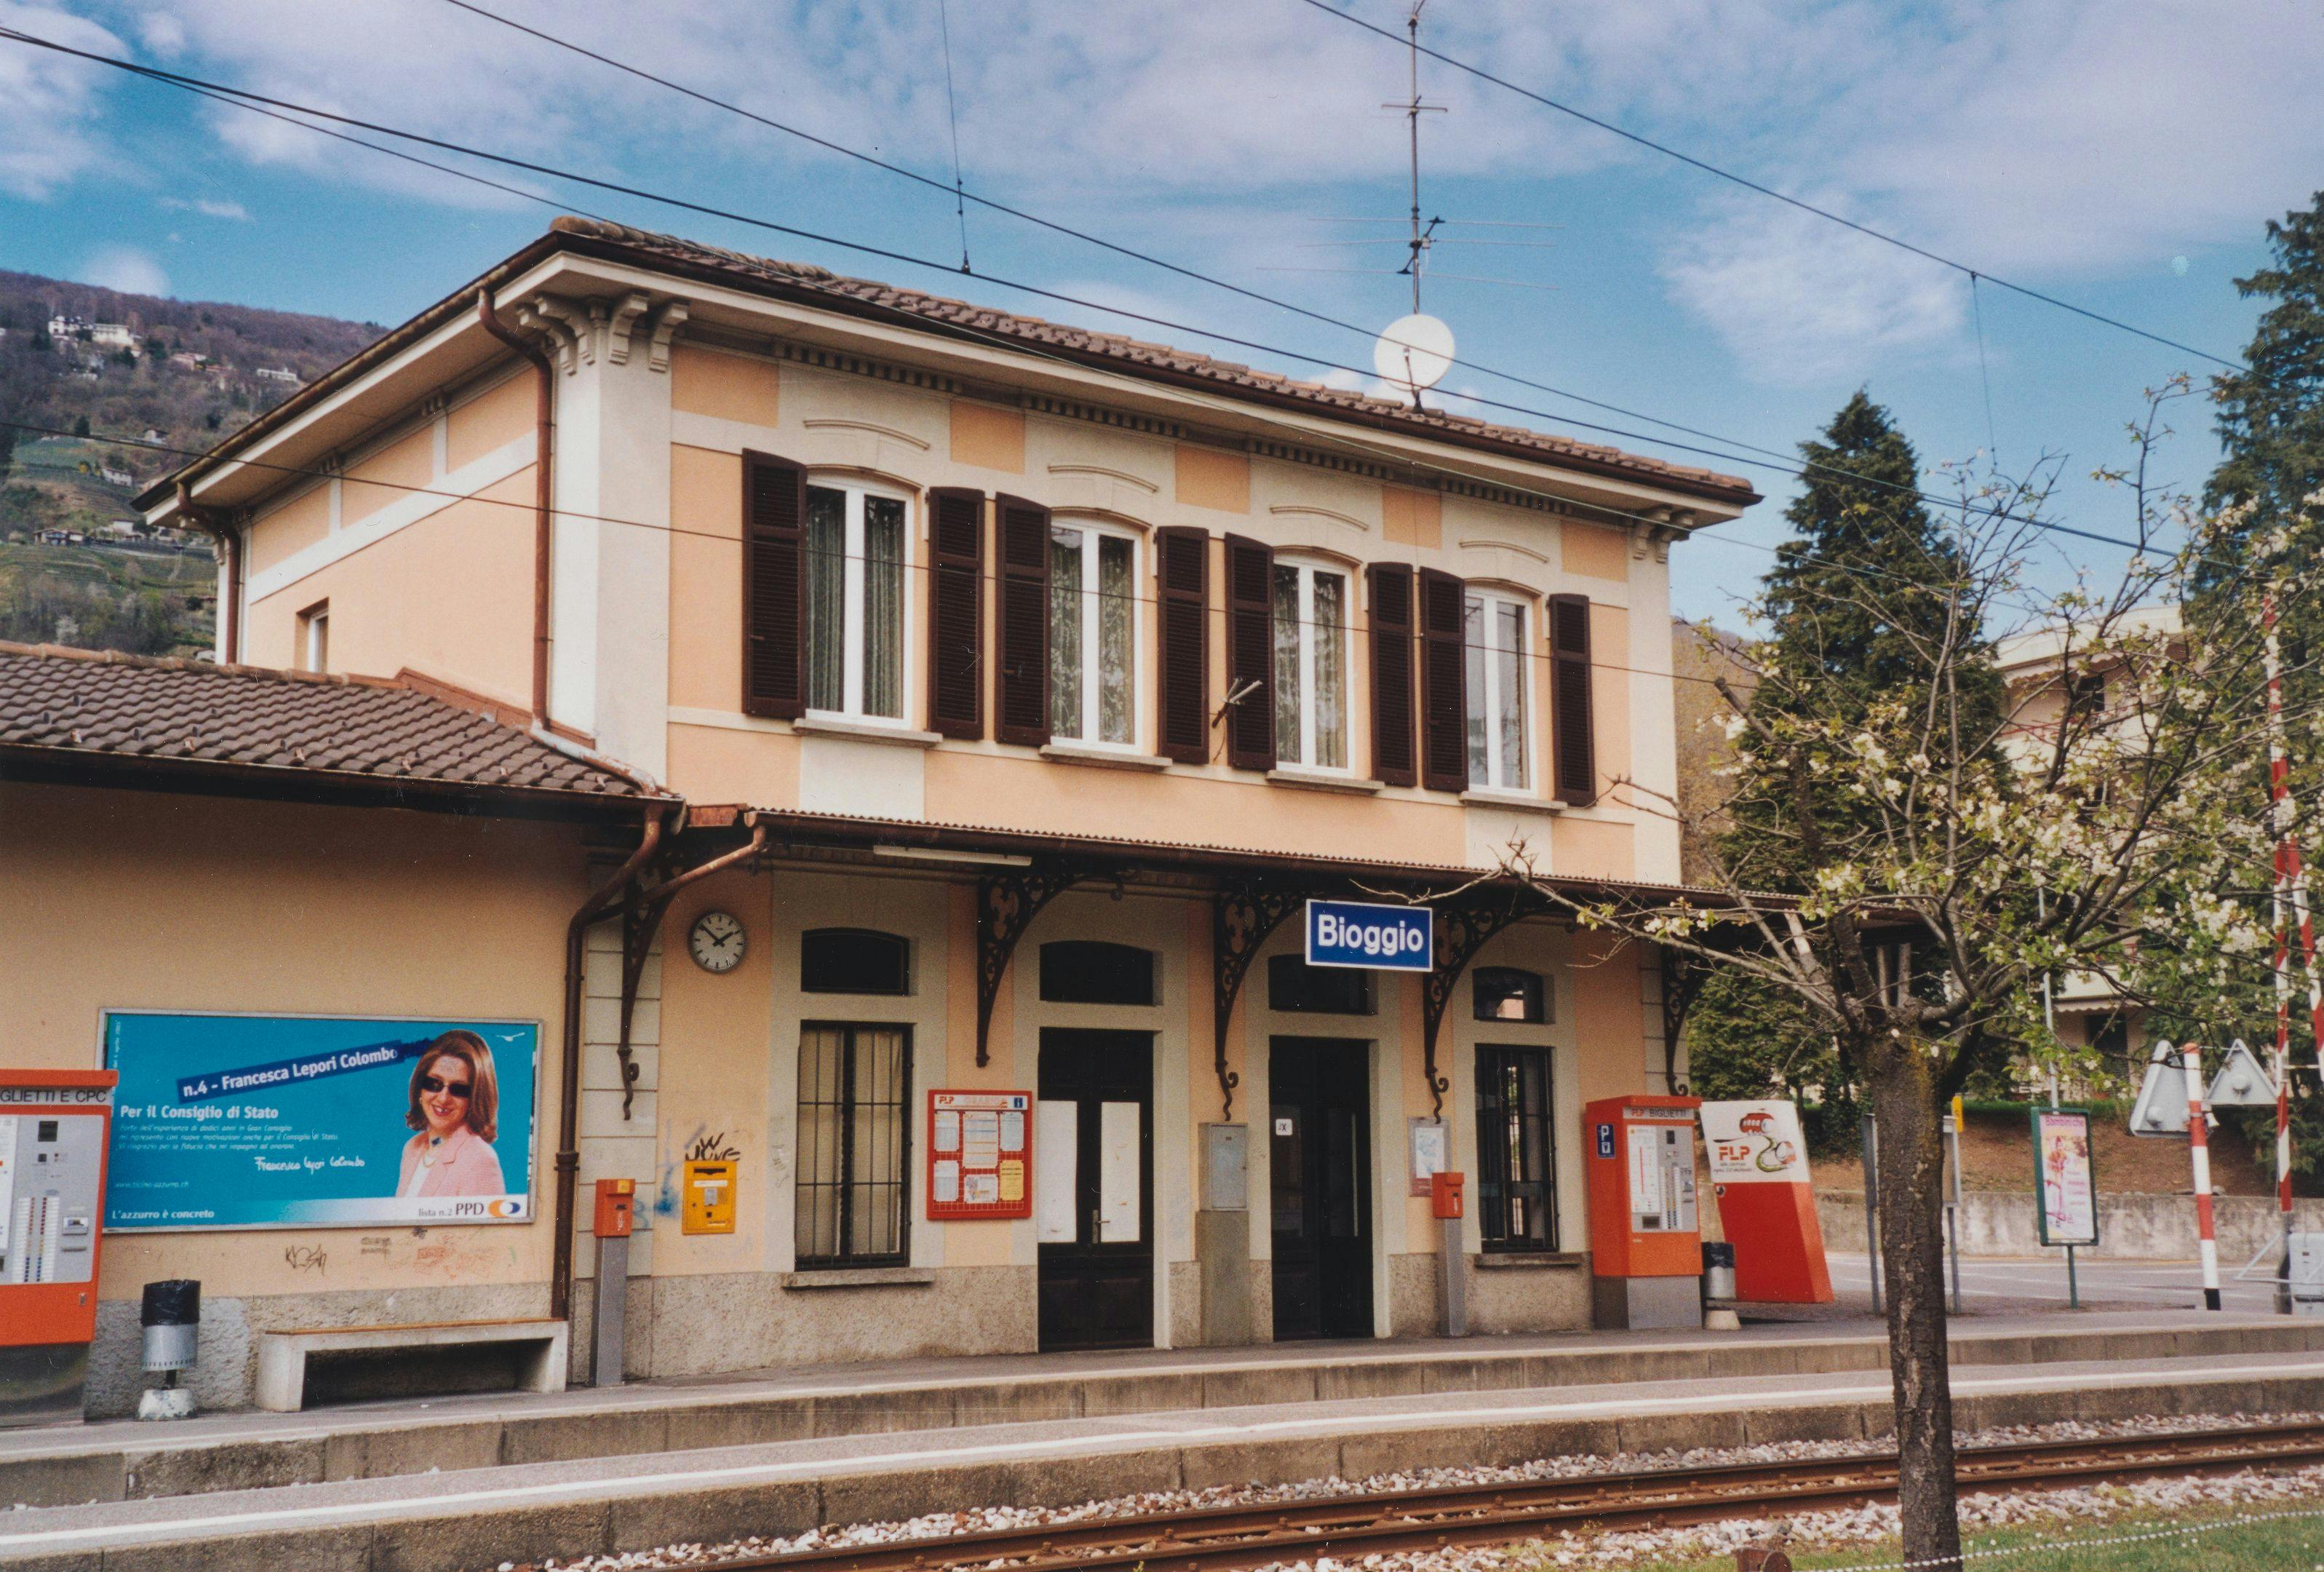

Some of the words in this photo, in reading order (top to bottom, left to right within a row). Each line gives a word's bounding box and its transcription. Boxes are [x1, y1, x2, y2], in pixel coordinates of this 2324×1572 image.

[1318, 913, 1423, 956] Bioggio
[183, 1080, 207, 1097] n.4
[222, 1068, 289, 1090] Francesca
[293, 1055, 337, 1077] Lepori
[60, 1091, 70, 1102] E
[76, 1091, 107, 1103] CPC
[939, 1096, 954, 1104] FLP
[121, 1105, 143, 1118] Per
[147, 1105, 156, 1118] il
[161, 1105, 223, 1122] Consiglio
[227, 1105, 239, 1119] di
[244, 1105, 279, 1119] Stato
[1632, 1108, 1644, 1116] FLP
[1650, 1108, 1687, 1117] BIGLIETTI
[264, 1124, 293, 1132] Consiglio
[1601, 1125, 1609, 1141] P
[283, 1134, 311, 1142] Consiglio
[1719, 1146, 1751, 1161] FLP
[112, 1210, 159, 1219] L'azzurro
[162, 1209, 169, 1218] è
[171, 1210, 215, 1218] concreto
[418, 1208, 436, 1217] lista
[455, 1202, 485, 1215] PPD
